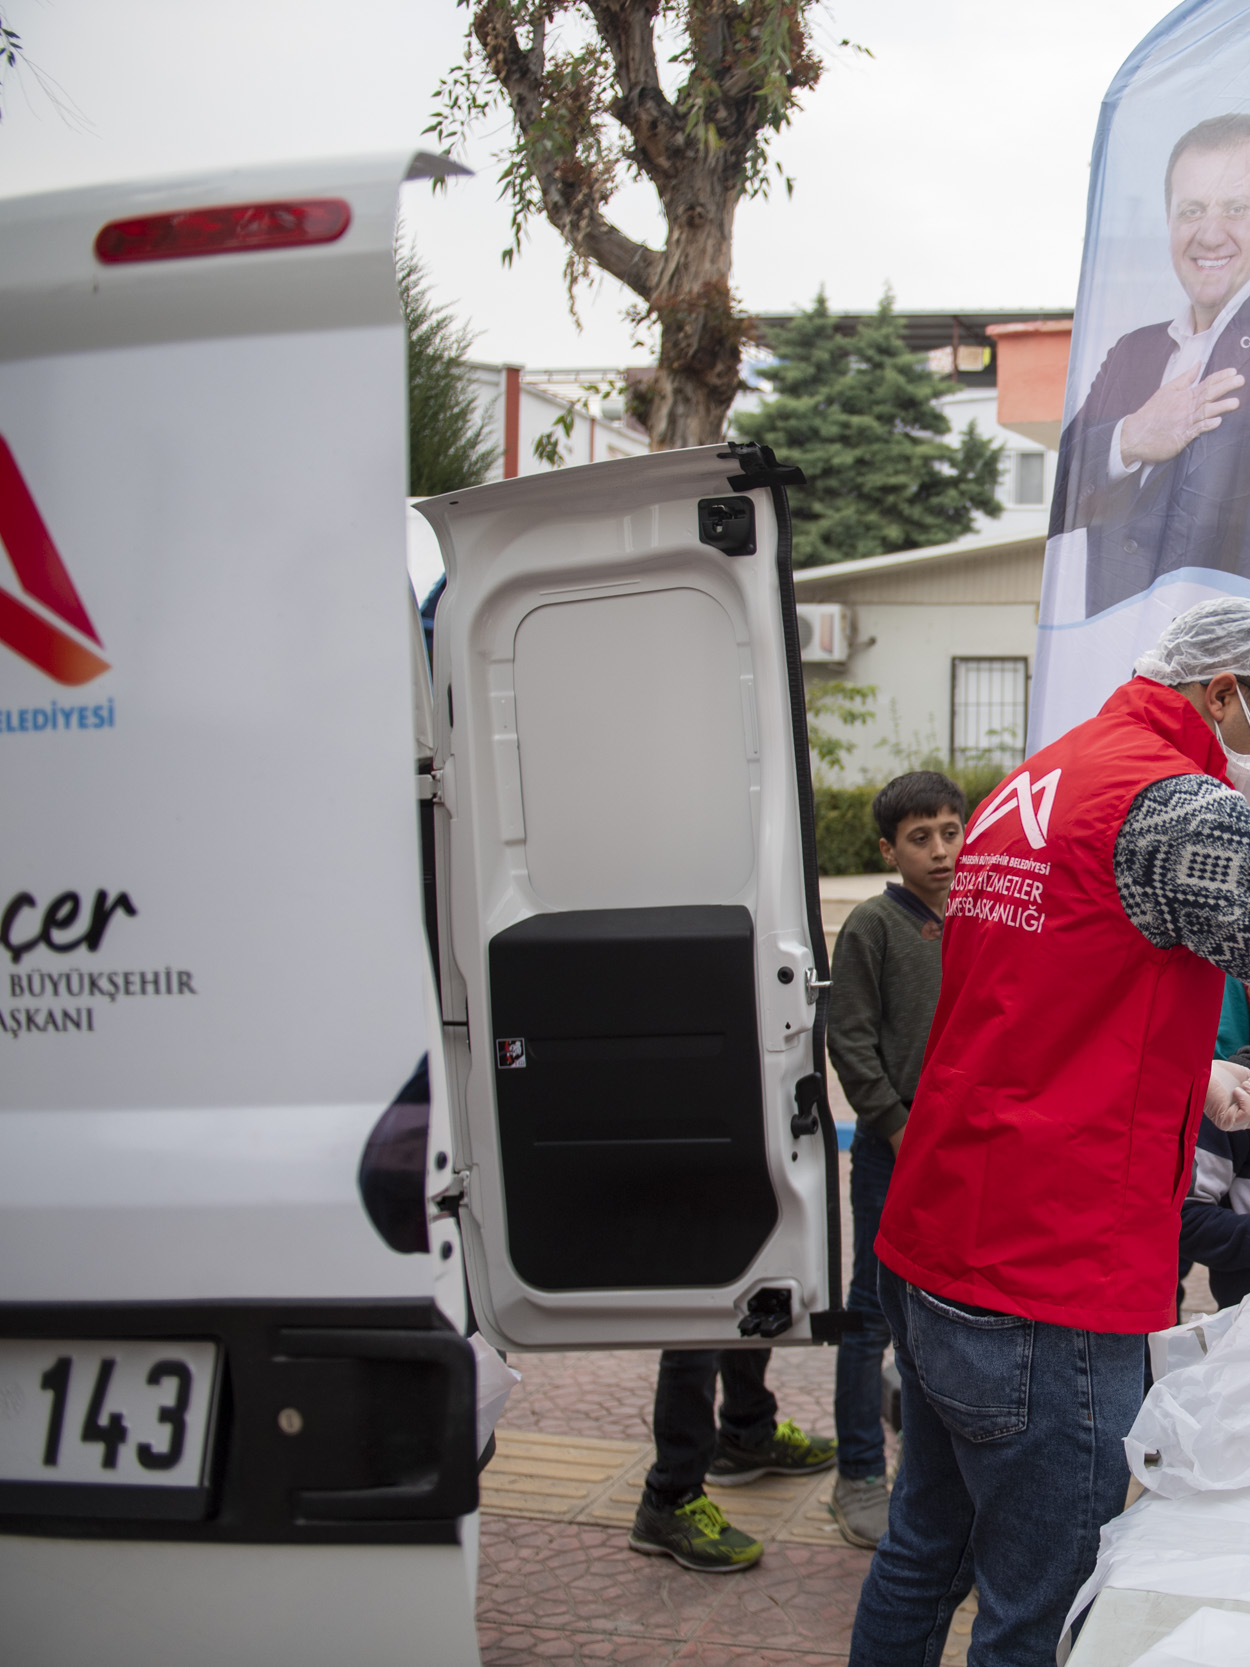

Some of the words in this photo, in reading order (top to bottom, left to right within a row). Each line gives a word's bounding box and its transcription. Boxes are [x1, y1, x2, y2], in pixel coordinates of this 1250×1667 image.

[1009, 858, 1051, 876] BELEDİYESİ
[977, 867, 1043, 904] HİZMETLER
[965, 897, 1045, 933] BAŞKANLIĞI
[9, 967, 197, 1002] BÜYÜKŞEHİR
[41, 1356, 194, 1471] 143
